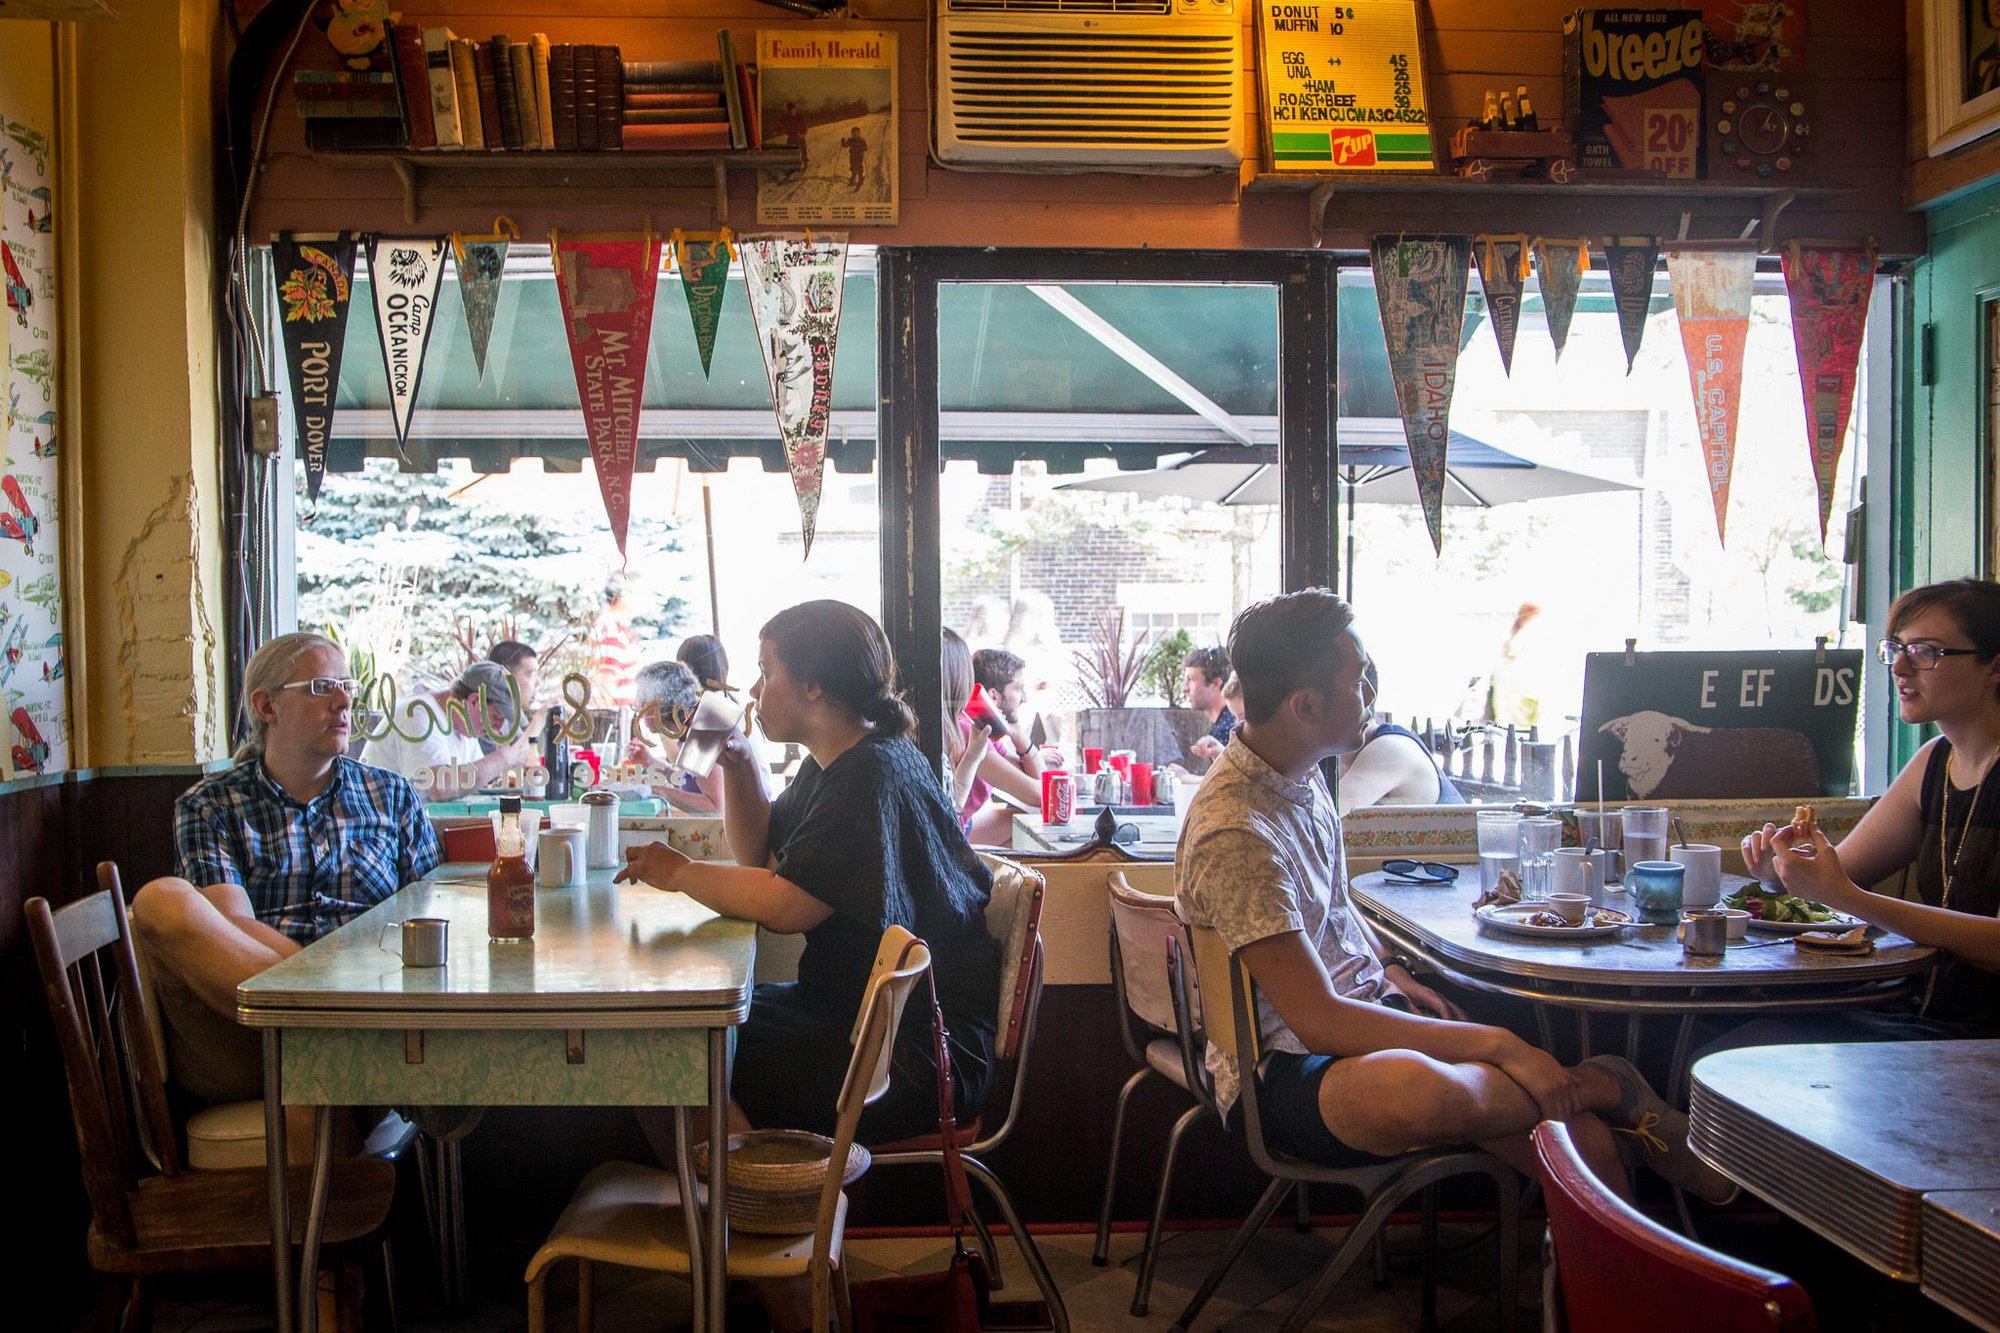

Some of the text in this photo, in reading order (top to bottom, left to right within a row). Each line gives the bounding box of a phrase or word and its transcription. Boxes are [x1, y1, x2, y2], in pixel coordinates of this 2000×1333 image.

[1271, 5, 1319, 19] DONUT
[1274, 19, 1344, 35] MUFFIN 10
[1604, 13, 1667, 23] ALL NEW BLUE
[772, 39, 825, 62] Family
[827, 39, 880, 59] Herald
[1282, 51, 1408, 67] EGG 45
[1582, 11, 1703, 81] breeze
[1287, 65, 1312, 79] UNA
[1308, 80, 1335, 93] HAM
[1279, 93, 1321, 107] ROAST
[1325, 94, 1357, 106] BEEF
[1582, 157, 1613, 168] TOWEL
[1650, 156, 1690, 174] OFF
[314, 252, 347, 295] CANADA
[409, 294, 430, 336] Camp
[387, 293, 409, 397] OCKANICKON
[596, 328, 630, 370] MT.
[584, 355, 606, 412] STATE
[1423, 362, 1447, 441] IDAHO
[300, 341, 332, 473] PORT DOVER
[608, 374, 637, 464] MITCHELL
[1705, 334, 1728, 490] U.S. CAPITOL
[1700, 667, 1855, 709] E EF DS
